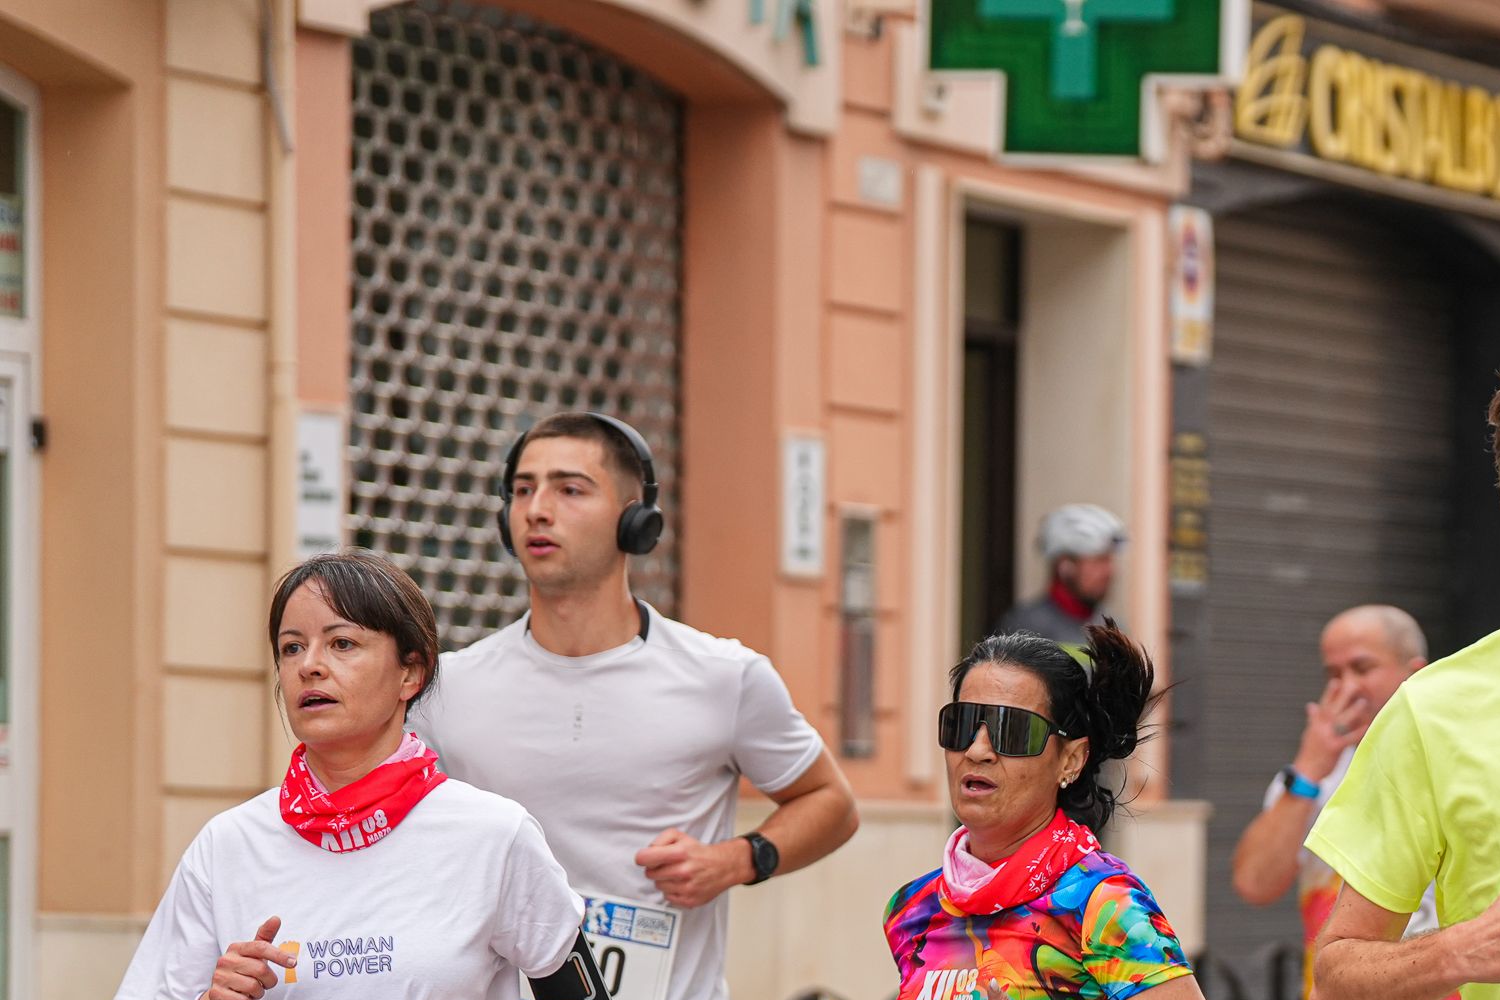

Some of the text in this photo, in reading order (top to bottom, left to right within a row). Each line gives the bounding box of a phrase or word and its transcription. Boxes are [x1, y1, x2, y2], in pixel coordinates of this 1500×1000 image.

[362, 809, 388, 833] 08
[367, 827, 392, 845] MARZO
[307, 936, 393, 958] WOMAN
[313, 954, 392, 979] POWER
[956, 968, 979, 992] 08
